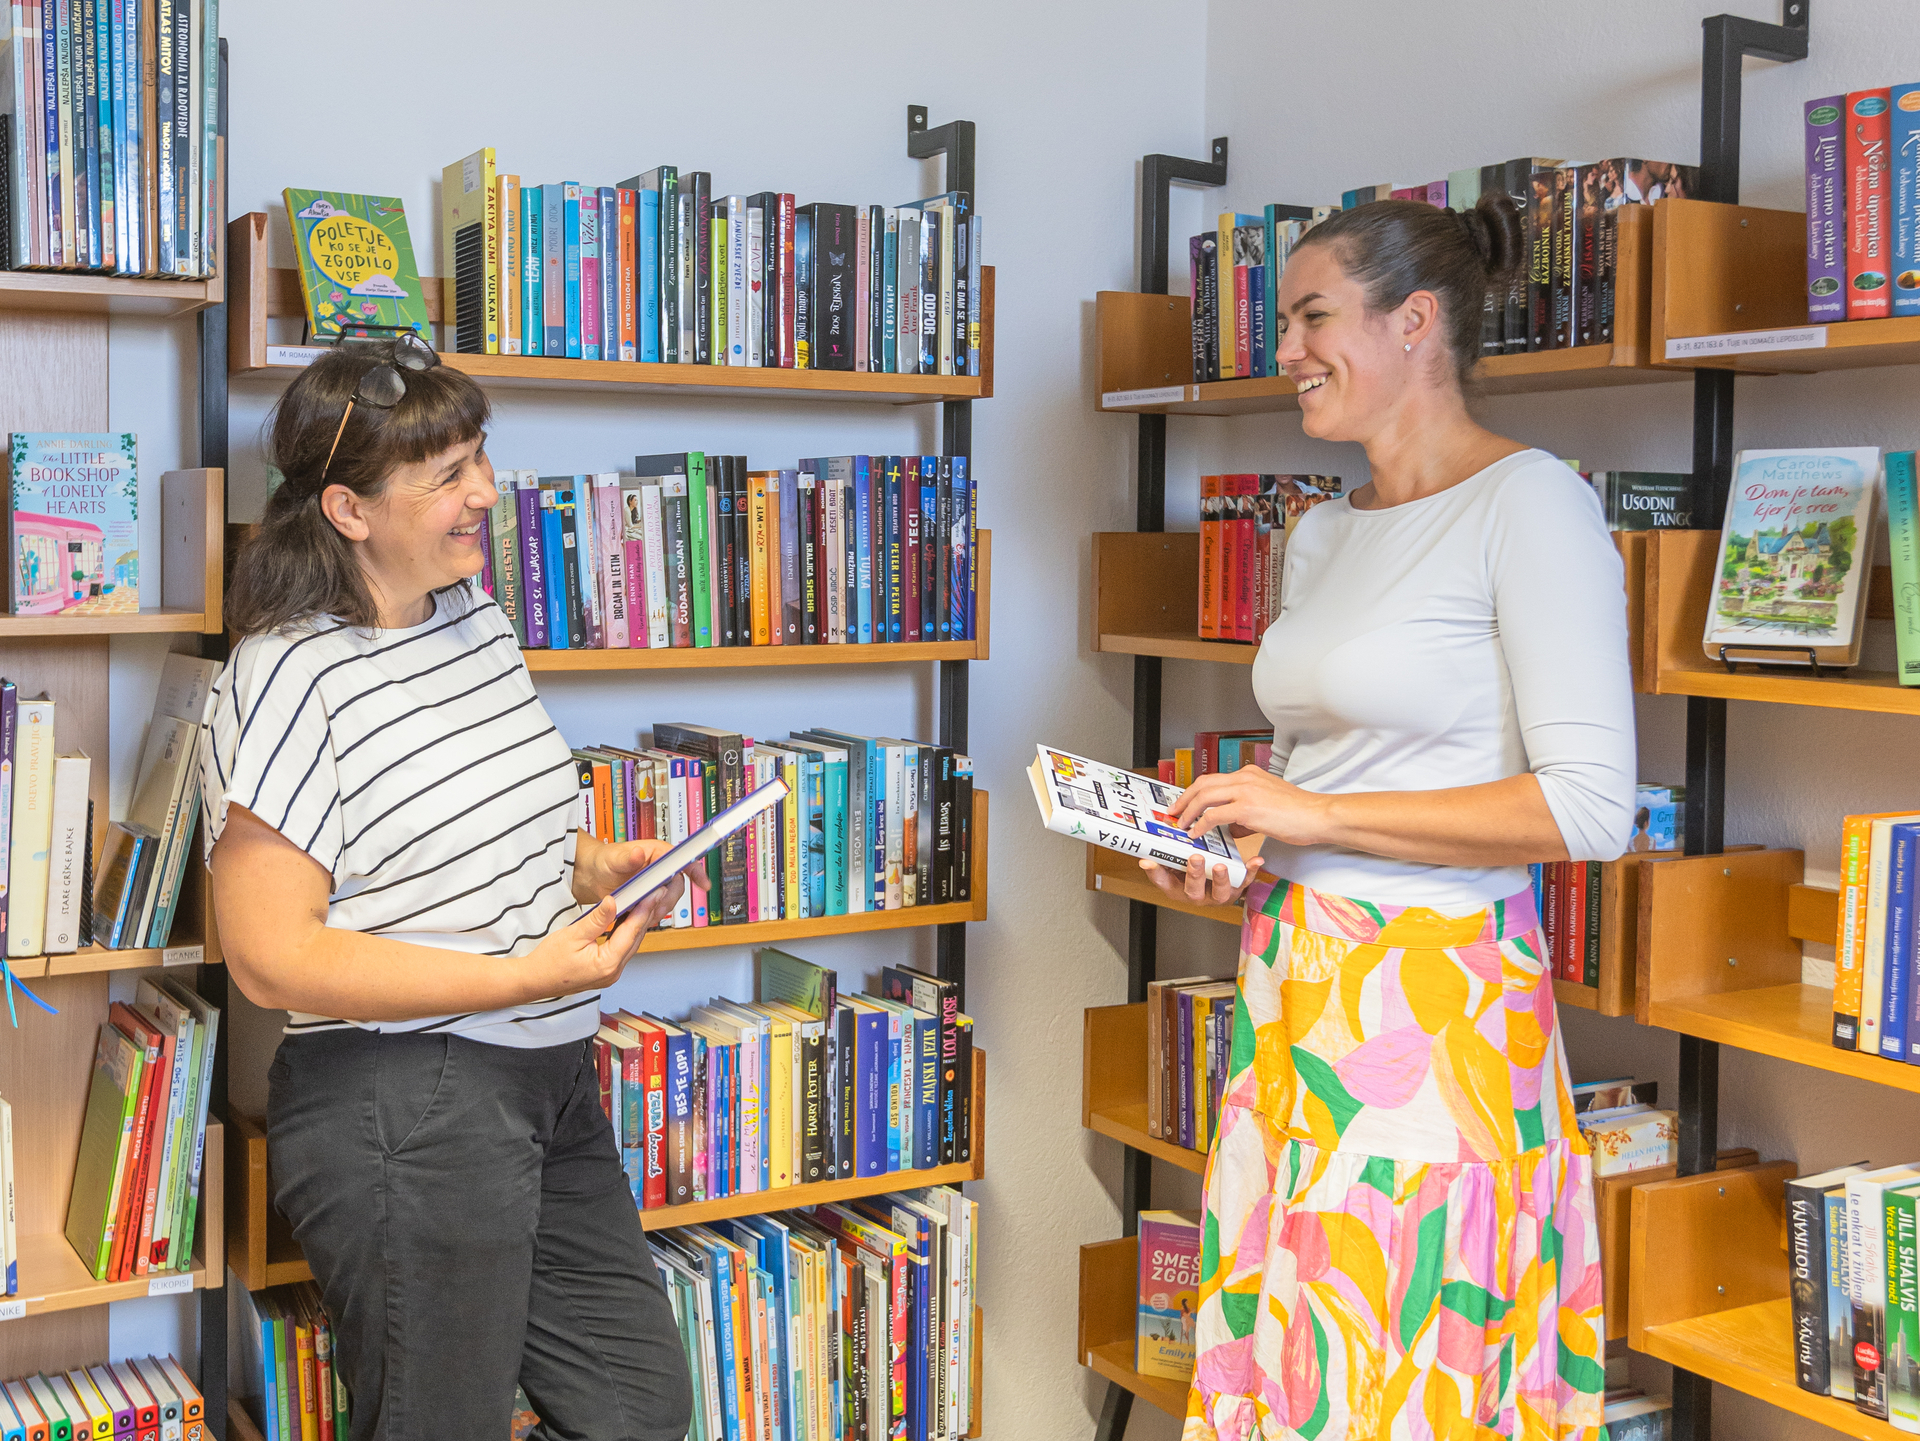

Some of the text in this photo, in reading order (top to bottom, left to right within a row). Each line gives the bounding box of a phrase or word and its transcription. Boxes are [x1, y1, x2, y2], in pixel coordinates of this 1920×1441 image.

[72, 1, 82, 34] MAČKAH
[84, 1, 93, 18] PSIH
[86, 29, 94, 55] KNJIGA
[160, 0, 171, 75] ATLAS MITOV
[75, 45, 83, 72] KNJIGA
[85, 58, 95, 96] NAJLEPŠA
[177, 13, 188, 138] ASTRONOMIJA ZA RADOVEDNE
[73, 75, 84, 112] NAJLEPŠA
[1814, 134, 1837, 172] Ljubi
[1856, 124, 1887, 189] Nežna
[487, 187, 495, 230] ZAKIYA
[1824, 177, 1836, 215] samo
[316, 222, 391, 251] POLETJE,
[700, 195, 709, 274] ZAZNAMOVANA
[1823, 220, 1836, 268] enkrat
[1866, 193, 1882, 259] upornica
[321, 254, 392, 270] ZGODILO
[329, 242, 376, 254] KO SE JE
[734, 219, 742, 290] JANUARSKE ZVEZDE
[1541, 227, 1550, 284] RAZBOJNIK
[336, 270, 360, 281] VSE
[718, 270, 726, 326] Charliejev
[901, 292, 910, 334] Dnevnik
[923, 294, 936, 334] ODPOR
[957, 279, 965, 339] NE DAM SE VAM
[884, 329, 894, 340] ČE
[1255, 300, 1264, 349] ZALJUBI
[36, 439, 113, 448] ANNIE DARLING
[61, 452, 106, 464] LITTLE
[30, 467, 120, 482] BOOKSHOP
[1762, 469, 1842, 481] Matthews
[1776, 458, 1831, 471] Carole
[47, 501, 107, 514] HEARTS
[52, 485, 108, 498] LONELY
[1622, 493, 1675, 511] USODNI
[1744, 484, 1851, 504] Dom je tam,
[909, 514, 918, 546] TECI
[1752, 502, 1838, 524] kjer je srce
[529, 536, 541, 582] ALJASKA?
[859, 555, 871, 589] TUJKA
[502, 538, 517, 620] LAŽNA MESTA
[610, 554, 624, 620] BRCAM IN LETIM
[675, 539, 688, 624] ČUDAK ROWAN
[806, 579, 815, 612] SMEHA
[829, 567, 838, 615] JOSIP JURČIČ
[891, 543, 900, 615] PETER IN PETRA
[533, 603, 544, 626] KDO
[937, 802, 951, 851] Severni sij
[1098, 829, 1141, 853] HIŠA
[61, 827, 75, 915] STARE GRŠKE BAJKE
[1569, 887, 1577, 936] HARRINGTON
[1844, 888, 1854, 967] KNJIGA ZAČETKOV
[167, 950, 201, 961] UGANKE
[904, 1024, 912, 1055] NAPAKO
[942, 996, 957, 1057] LOLA ROSE
[172, 1038, 186, 1097] MI SMO SLIKE
[674, 1049, 689, 1116] BES TE LOPI
[922, 1028, 938, 1105] ZMAJSKI JEZIK
[807, 1058, 817, 1137] HARRY POTTER
[890, 1084, 899, 1127] KOLIKO ŠE?
[904, 1068, 912, 1109] PRINCESKA
[145, 1188, 156, 1203] ŠOLI
[143, 1213, 154, 1237] NANDE
[1791, 1199, 1809, 1279] GOTIKANA
[1829, 1205, 1838, 1235] Sladke
[1830, 1237, 1839, 1268] drobne
[1886, 1206, 1898, 1304] Vroče zimske noči
[1898, 1207, 1916, 1312] JILL SHALVIS
[151, 1279, 190, 1290] SLIKOPISI
[721, 1279, 733, 1361] NEDELJSKI PROJEKTI
[938, 1348, 946, 1406] ENCIKLOPEDIJA
[937, 1407, 946, 1434] ŠOLSKA
